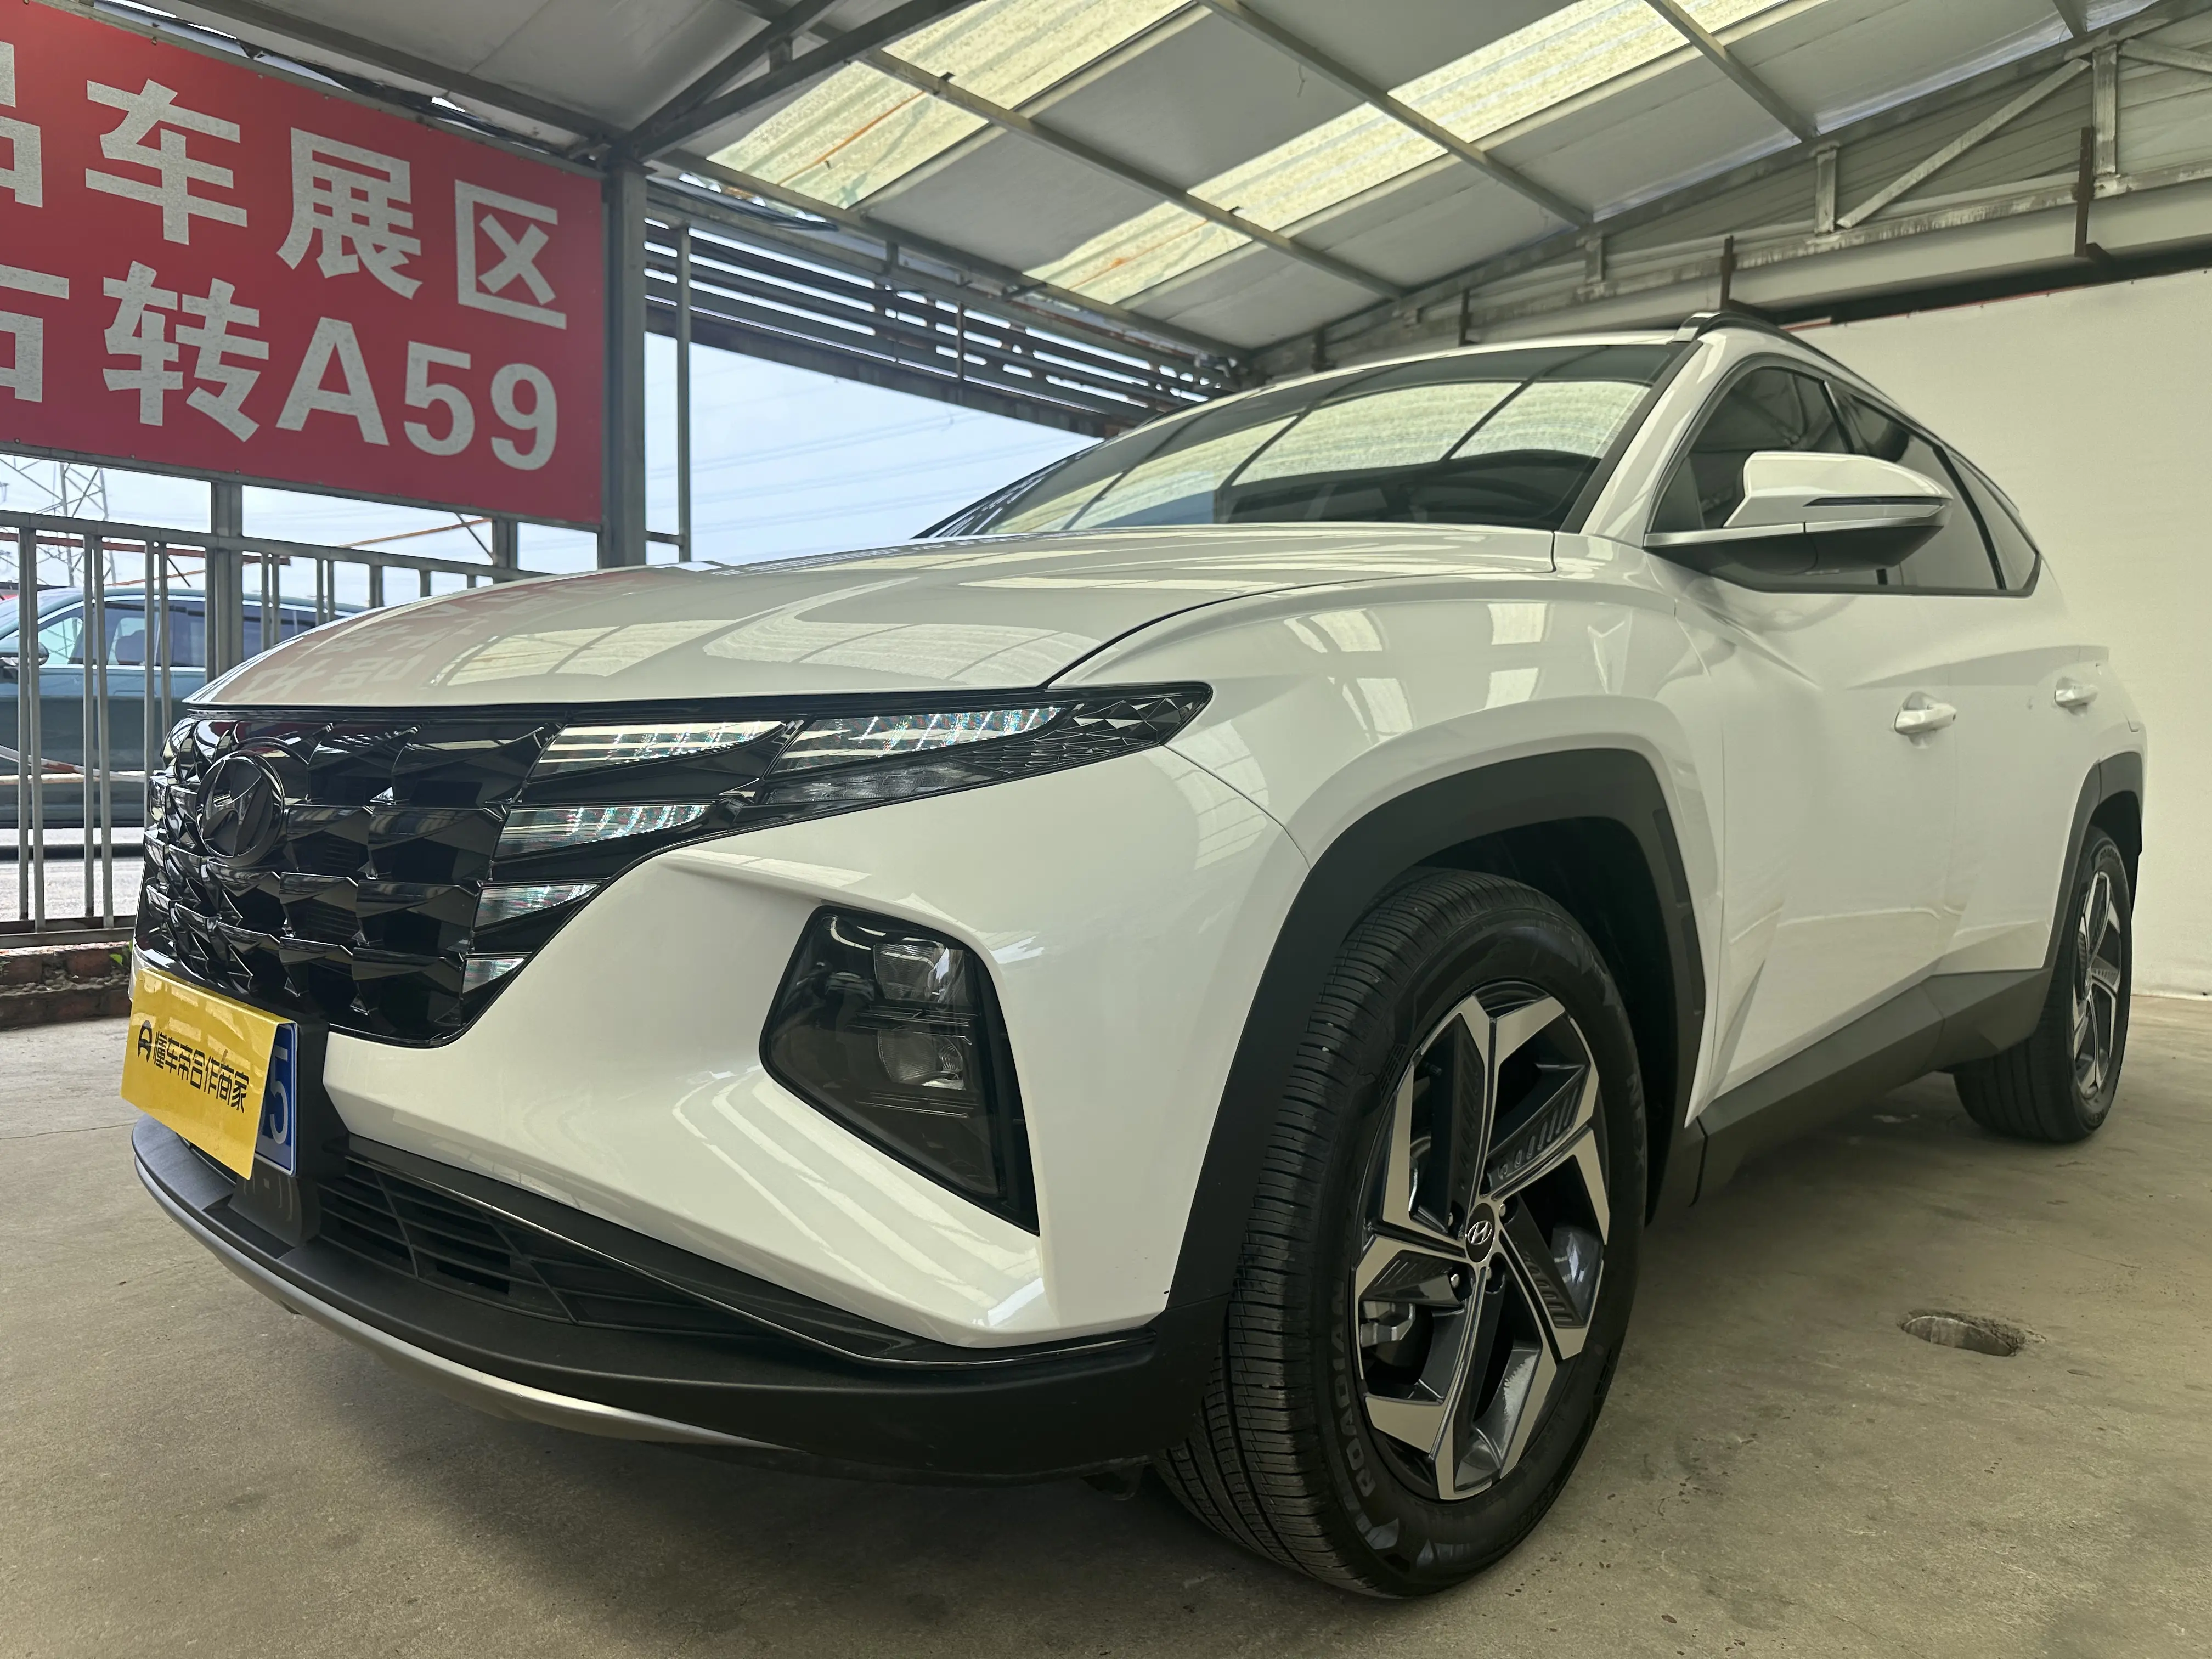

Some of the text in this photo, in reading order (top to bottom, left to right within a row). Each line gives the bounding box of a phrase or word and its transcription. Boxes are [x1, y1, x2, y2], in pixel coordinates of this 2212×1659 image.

[0, 41, 566, 329] 车展区
[153, 1030, 250, 1114] 懂车帝合作商家
[1331, 1277, 1376, 1497] ROADIAN
